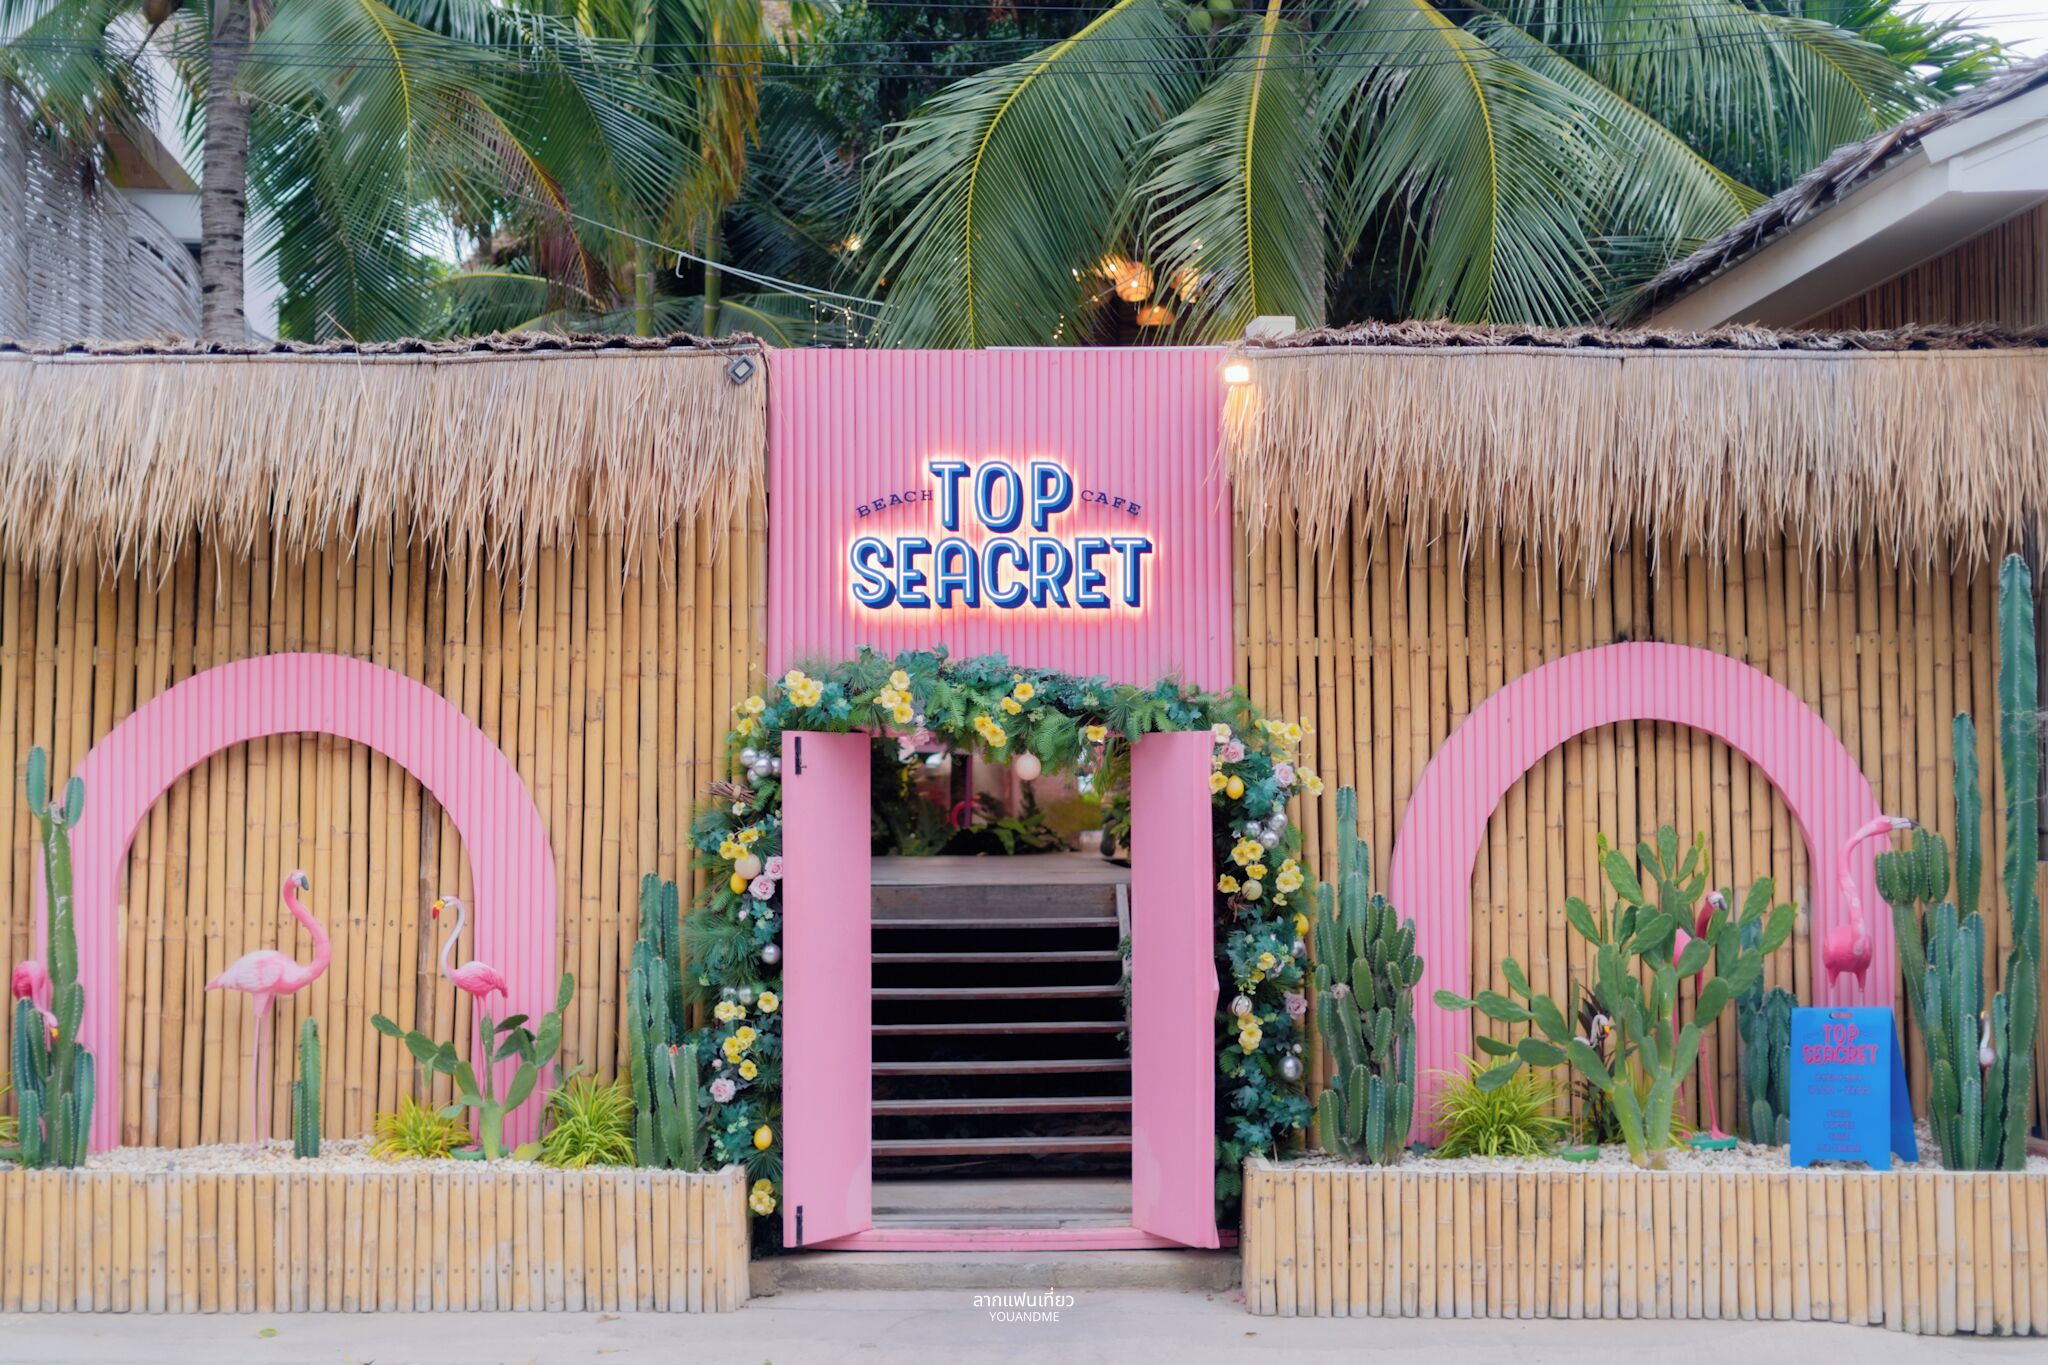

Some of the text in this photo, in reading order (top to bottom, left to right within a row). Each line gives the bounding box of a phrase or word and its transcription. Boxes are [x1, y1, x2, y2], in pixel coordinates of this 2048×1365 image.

[856, 489, 1141, 518] BEACH CAFE
[929, 461, 1073, 533] TOP
[850, 536, 1153, 609] SEACRET
[1823, 1024, 1860, 1044] TOP
[1802, 1044, 1879, 1065] SEACRET
